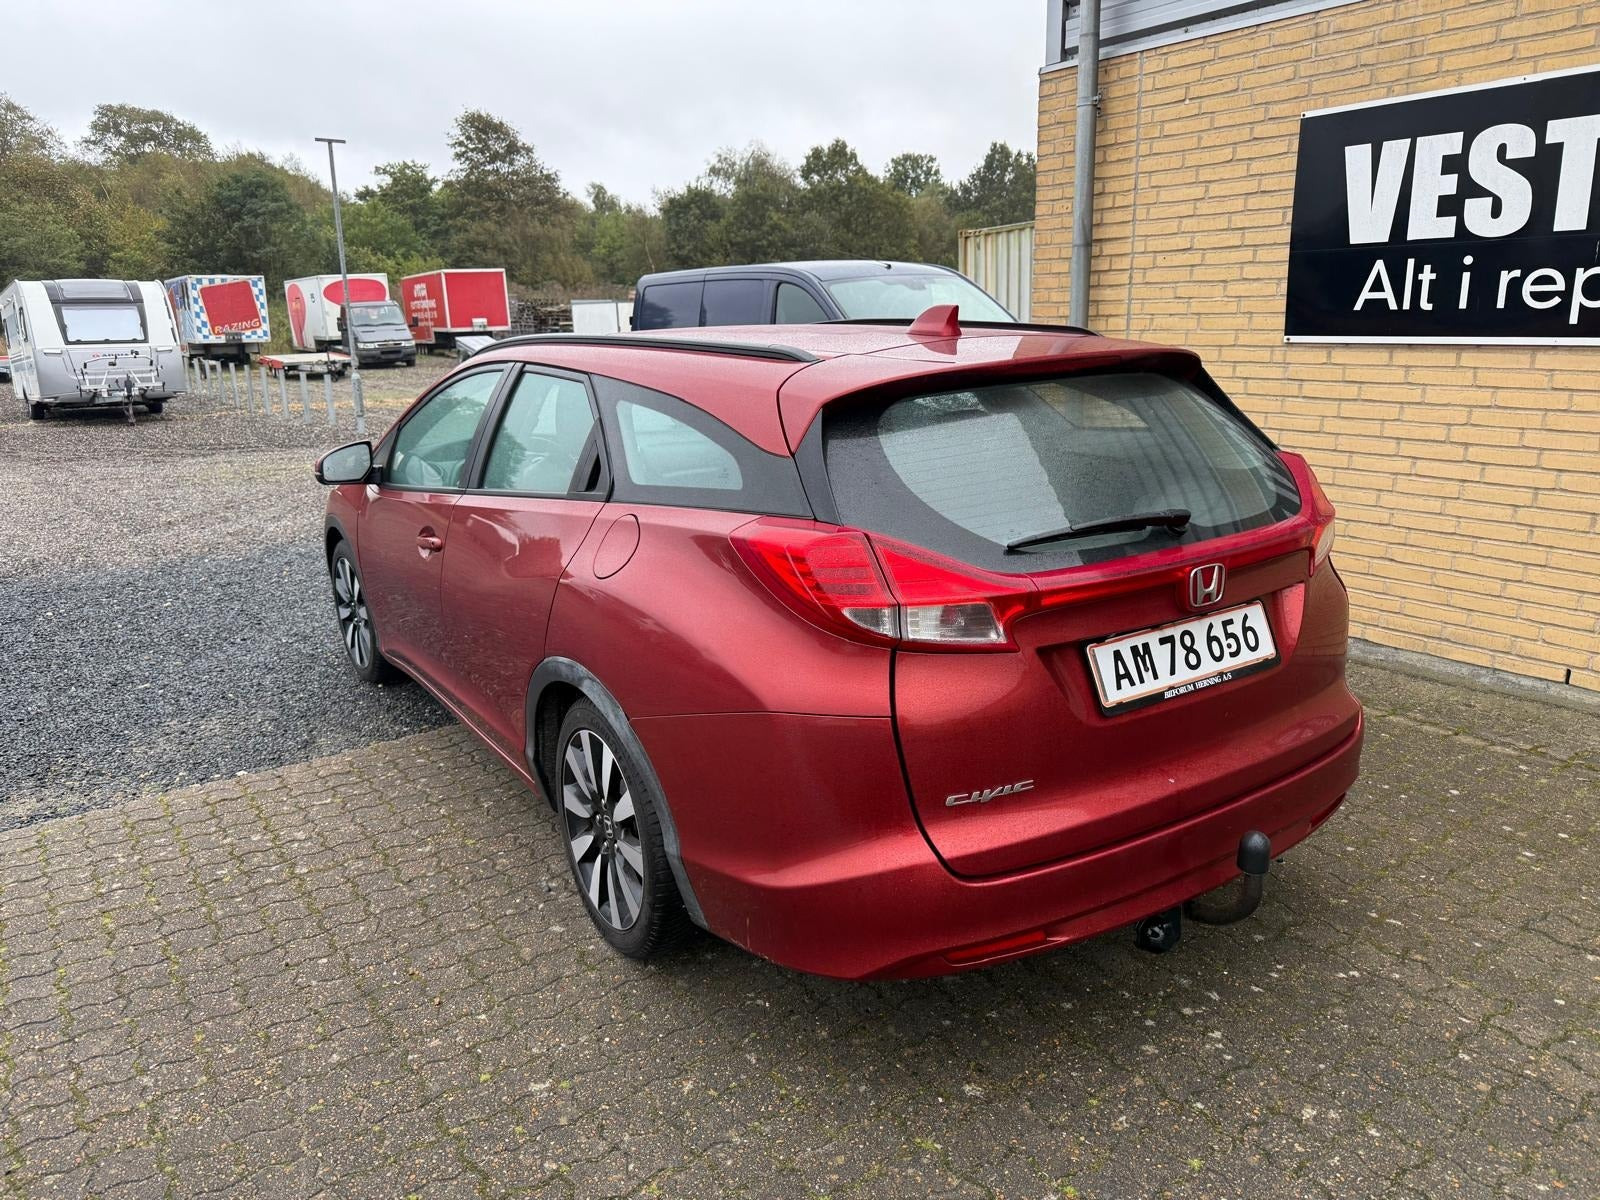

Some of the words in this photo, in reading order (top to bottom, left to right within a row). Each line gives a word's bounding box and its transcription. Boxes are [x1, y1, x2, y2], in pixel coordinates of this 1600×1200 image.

[1345, 114, 1600, 244] VEST
[1353, 258, 1437, 311] Alt
[1458, 255, 1474, 309] i
[214, 318, 260, 334] RAZING
[1112, 641, 1159, 691] AM
[1159, 629, 1202, 677] 78
[1206, 612, 1260, 663] 656
[1222, 672, 1233, 682] A/S
[945, 779, 1034, 806] CIVIC
